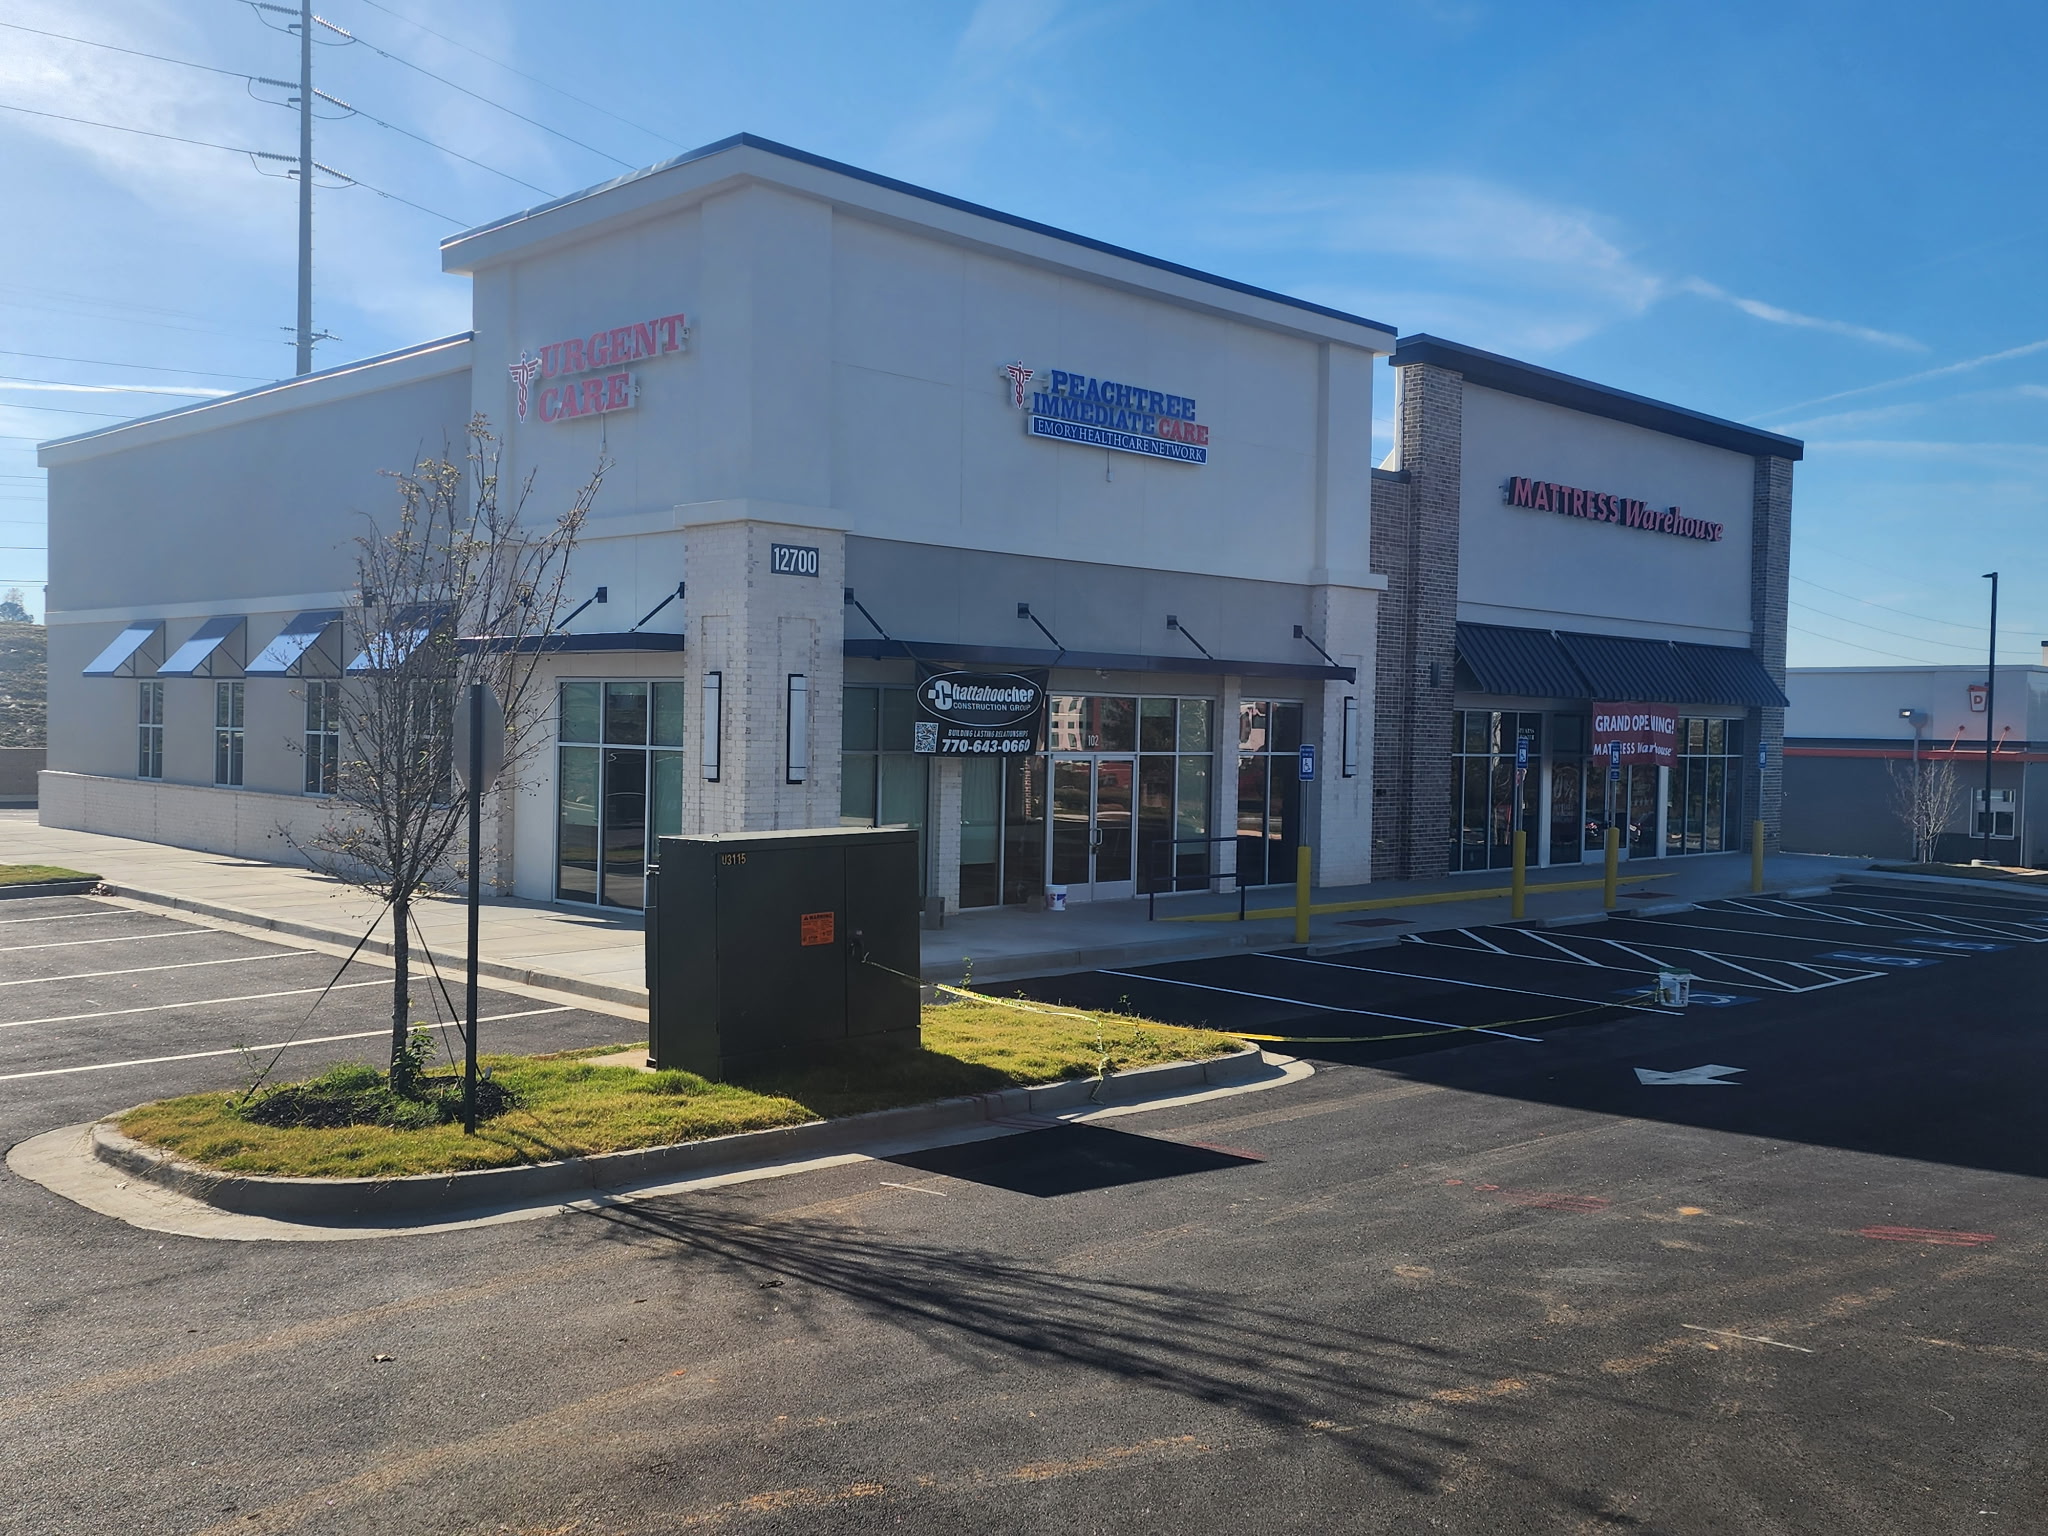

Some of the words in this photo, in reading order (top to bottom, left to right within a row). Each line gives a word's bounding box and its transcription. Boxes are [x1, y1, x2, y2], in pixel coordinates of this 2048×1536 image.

[540, 313, 686, 379] URGENT
[538, 372, 631, 423] CARE
[1051, 369, 1196, 422] PEACHTREE
[1033, 391, 1156, 436] IMMEDIATE
[1158, 418, 1209, 446] CARE
[1037, 419, 1078, 439] EMORY
[1078, 429, 1149, 452] HEALTHCARE
[1151, 441, 1204, 462] NETWORK
[1508, 476, 1620, 524] MATTRESS
[1620, 498, 1724, 542] Warehouse
[773, 547, 817, 574] 12700
[934, 680, 1035, 711] Chattahoochee
[953, 701, 1007, 712] CONSTRUCTION
[1009, 703, 1031, 712] GROUP
[1973, 695, 1984, 705] D
[1595, 714, 1631, 732] GRAND
[941, 738, 1031, 753] 770-643-0660
[1087, 734, 1099, 747] 102
[1593, 742, 1636, 756] MATRESS
[721, 852, 747, 866] U3115
